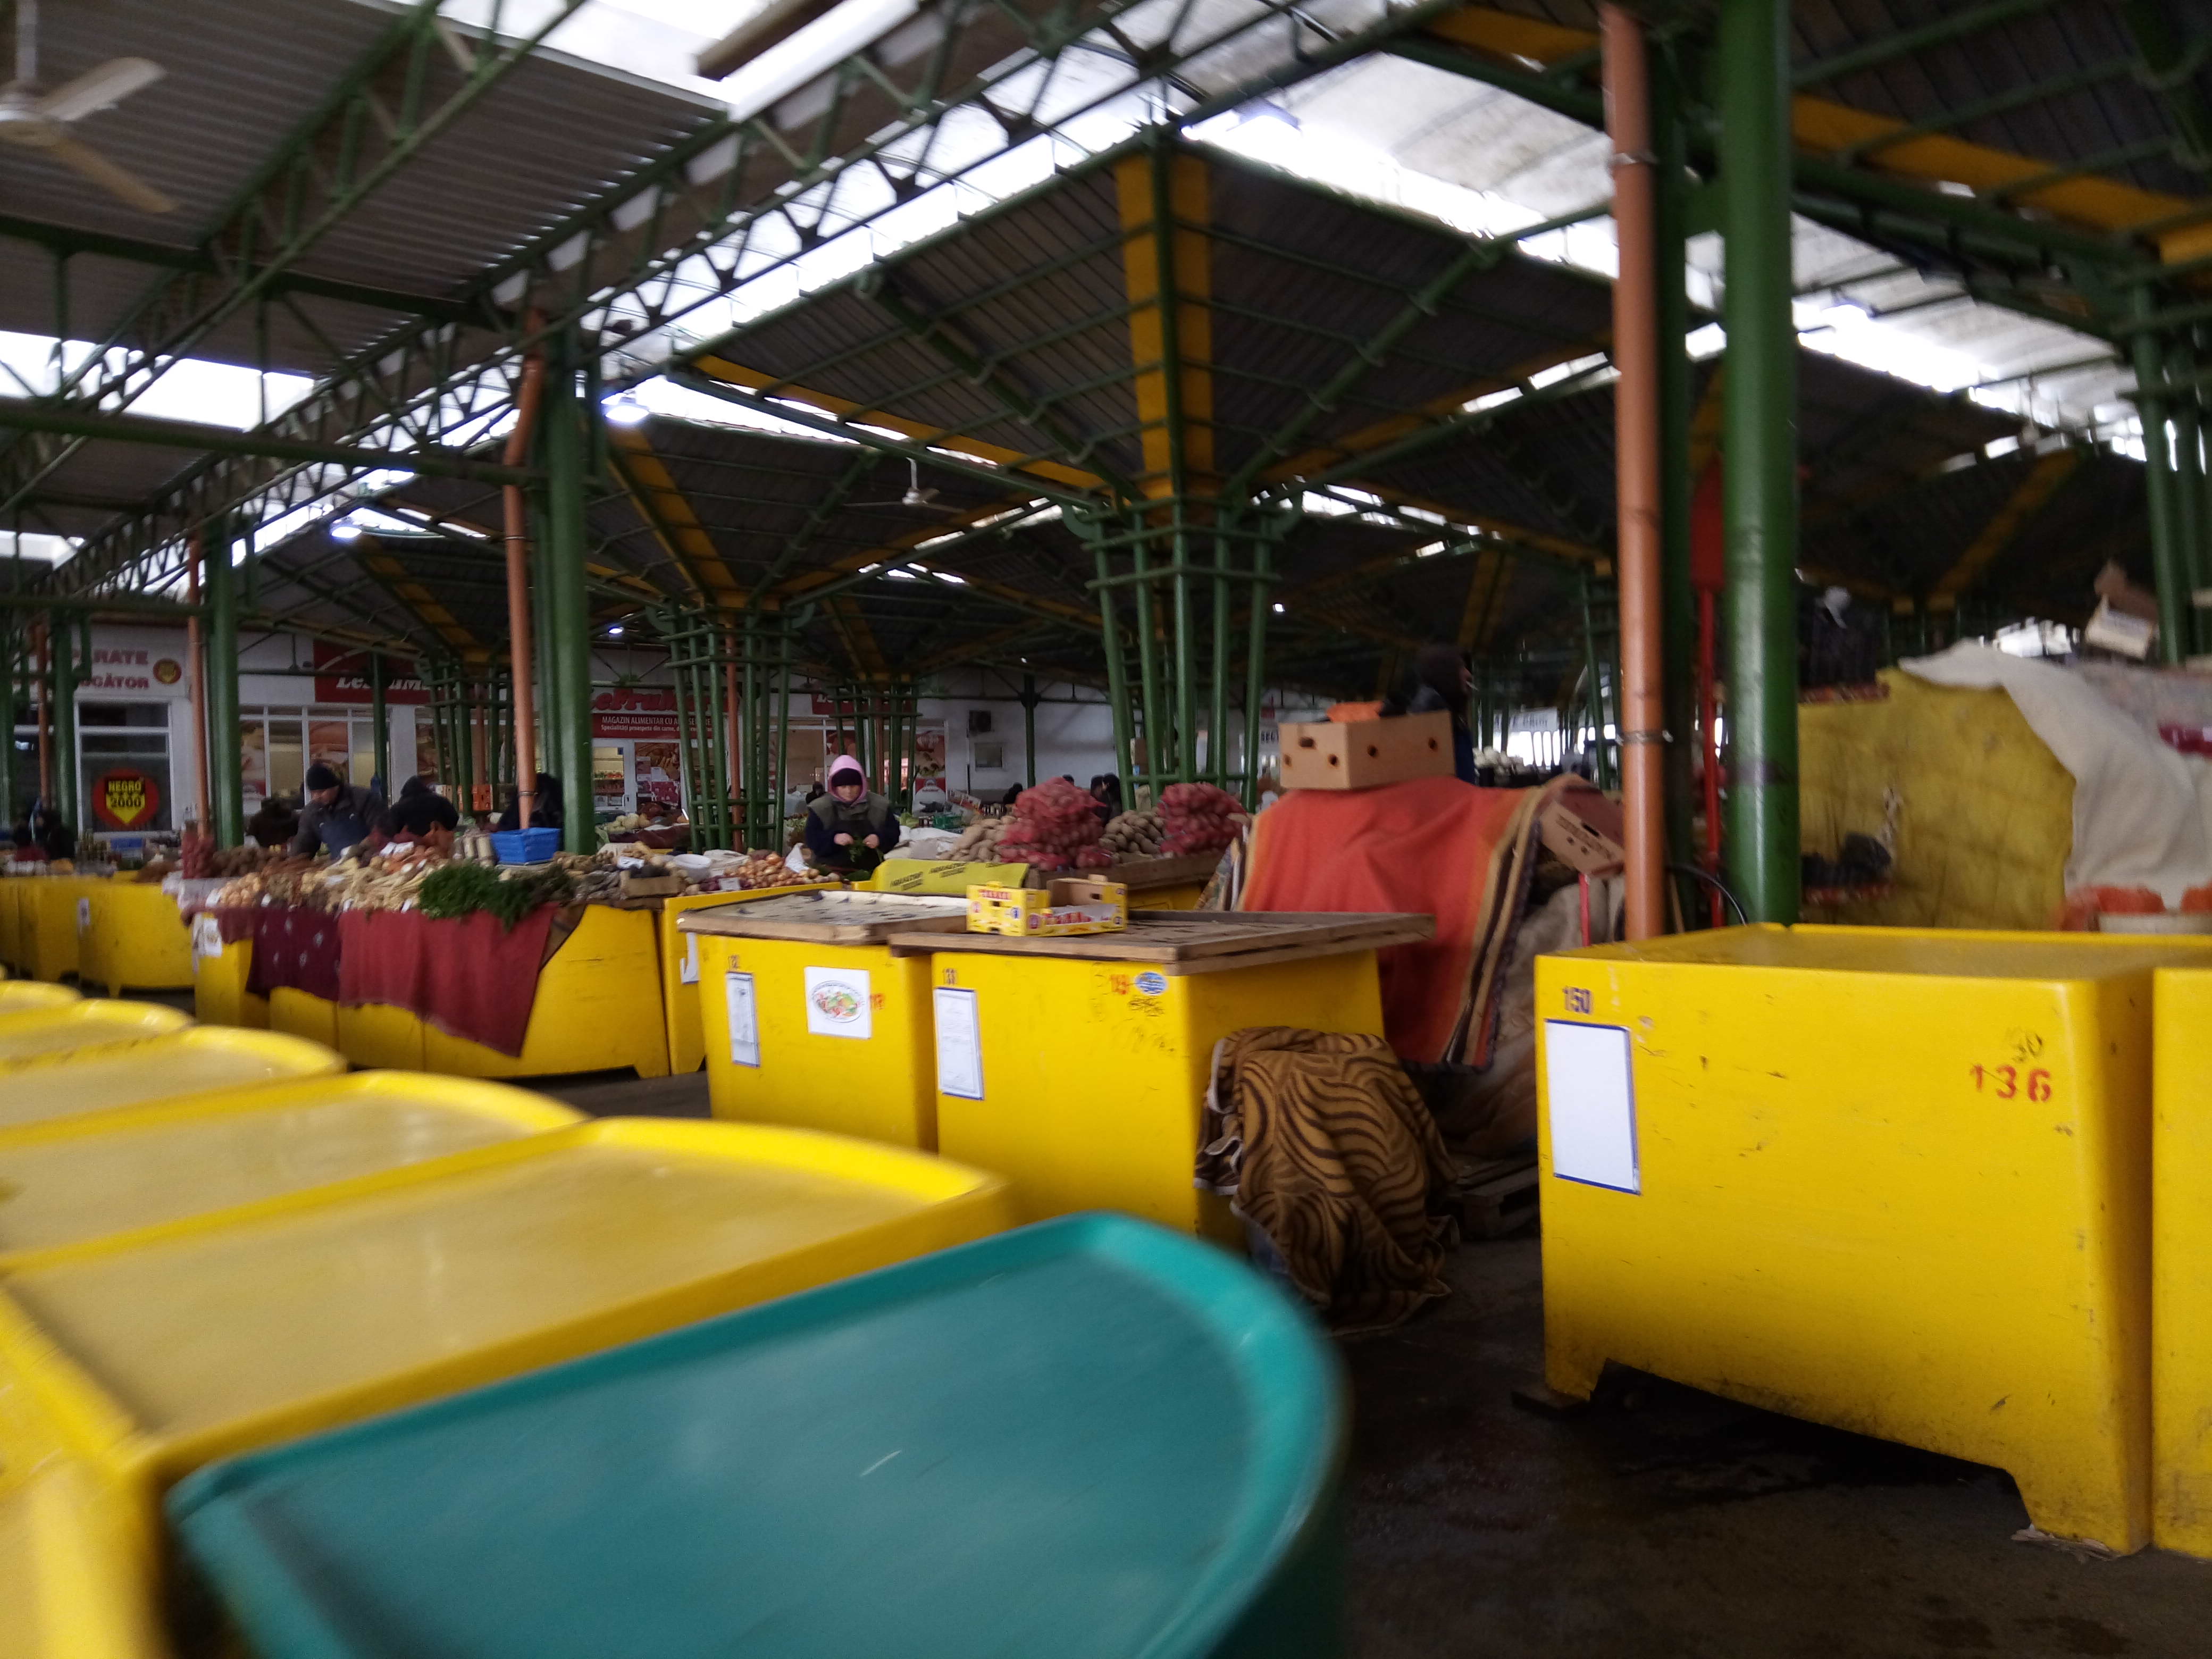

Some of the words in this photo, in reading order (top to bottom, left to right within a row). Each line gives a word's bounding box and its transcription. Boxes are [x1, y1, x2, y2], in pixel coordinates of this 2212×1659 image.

[602, 716, 630, 724] MAGAZIN
[631, 716, 664, 725] ALIMENTAR
[108, 780, 142, 792] NEGRO
[111, 798, 141, 808] 2000
[1563, 987, 1593, 1015] 150
[1969, 1063, 2051, 1102] 136
